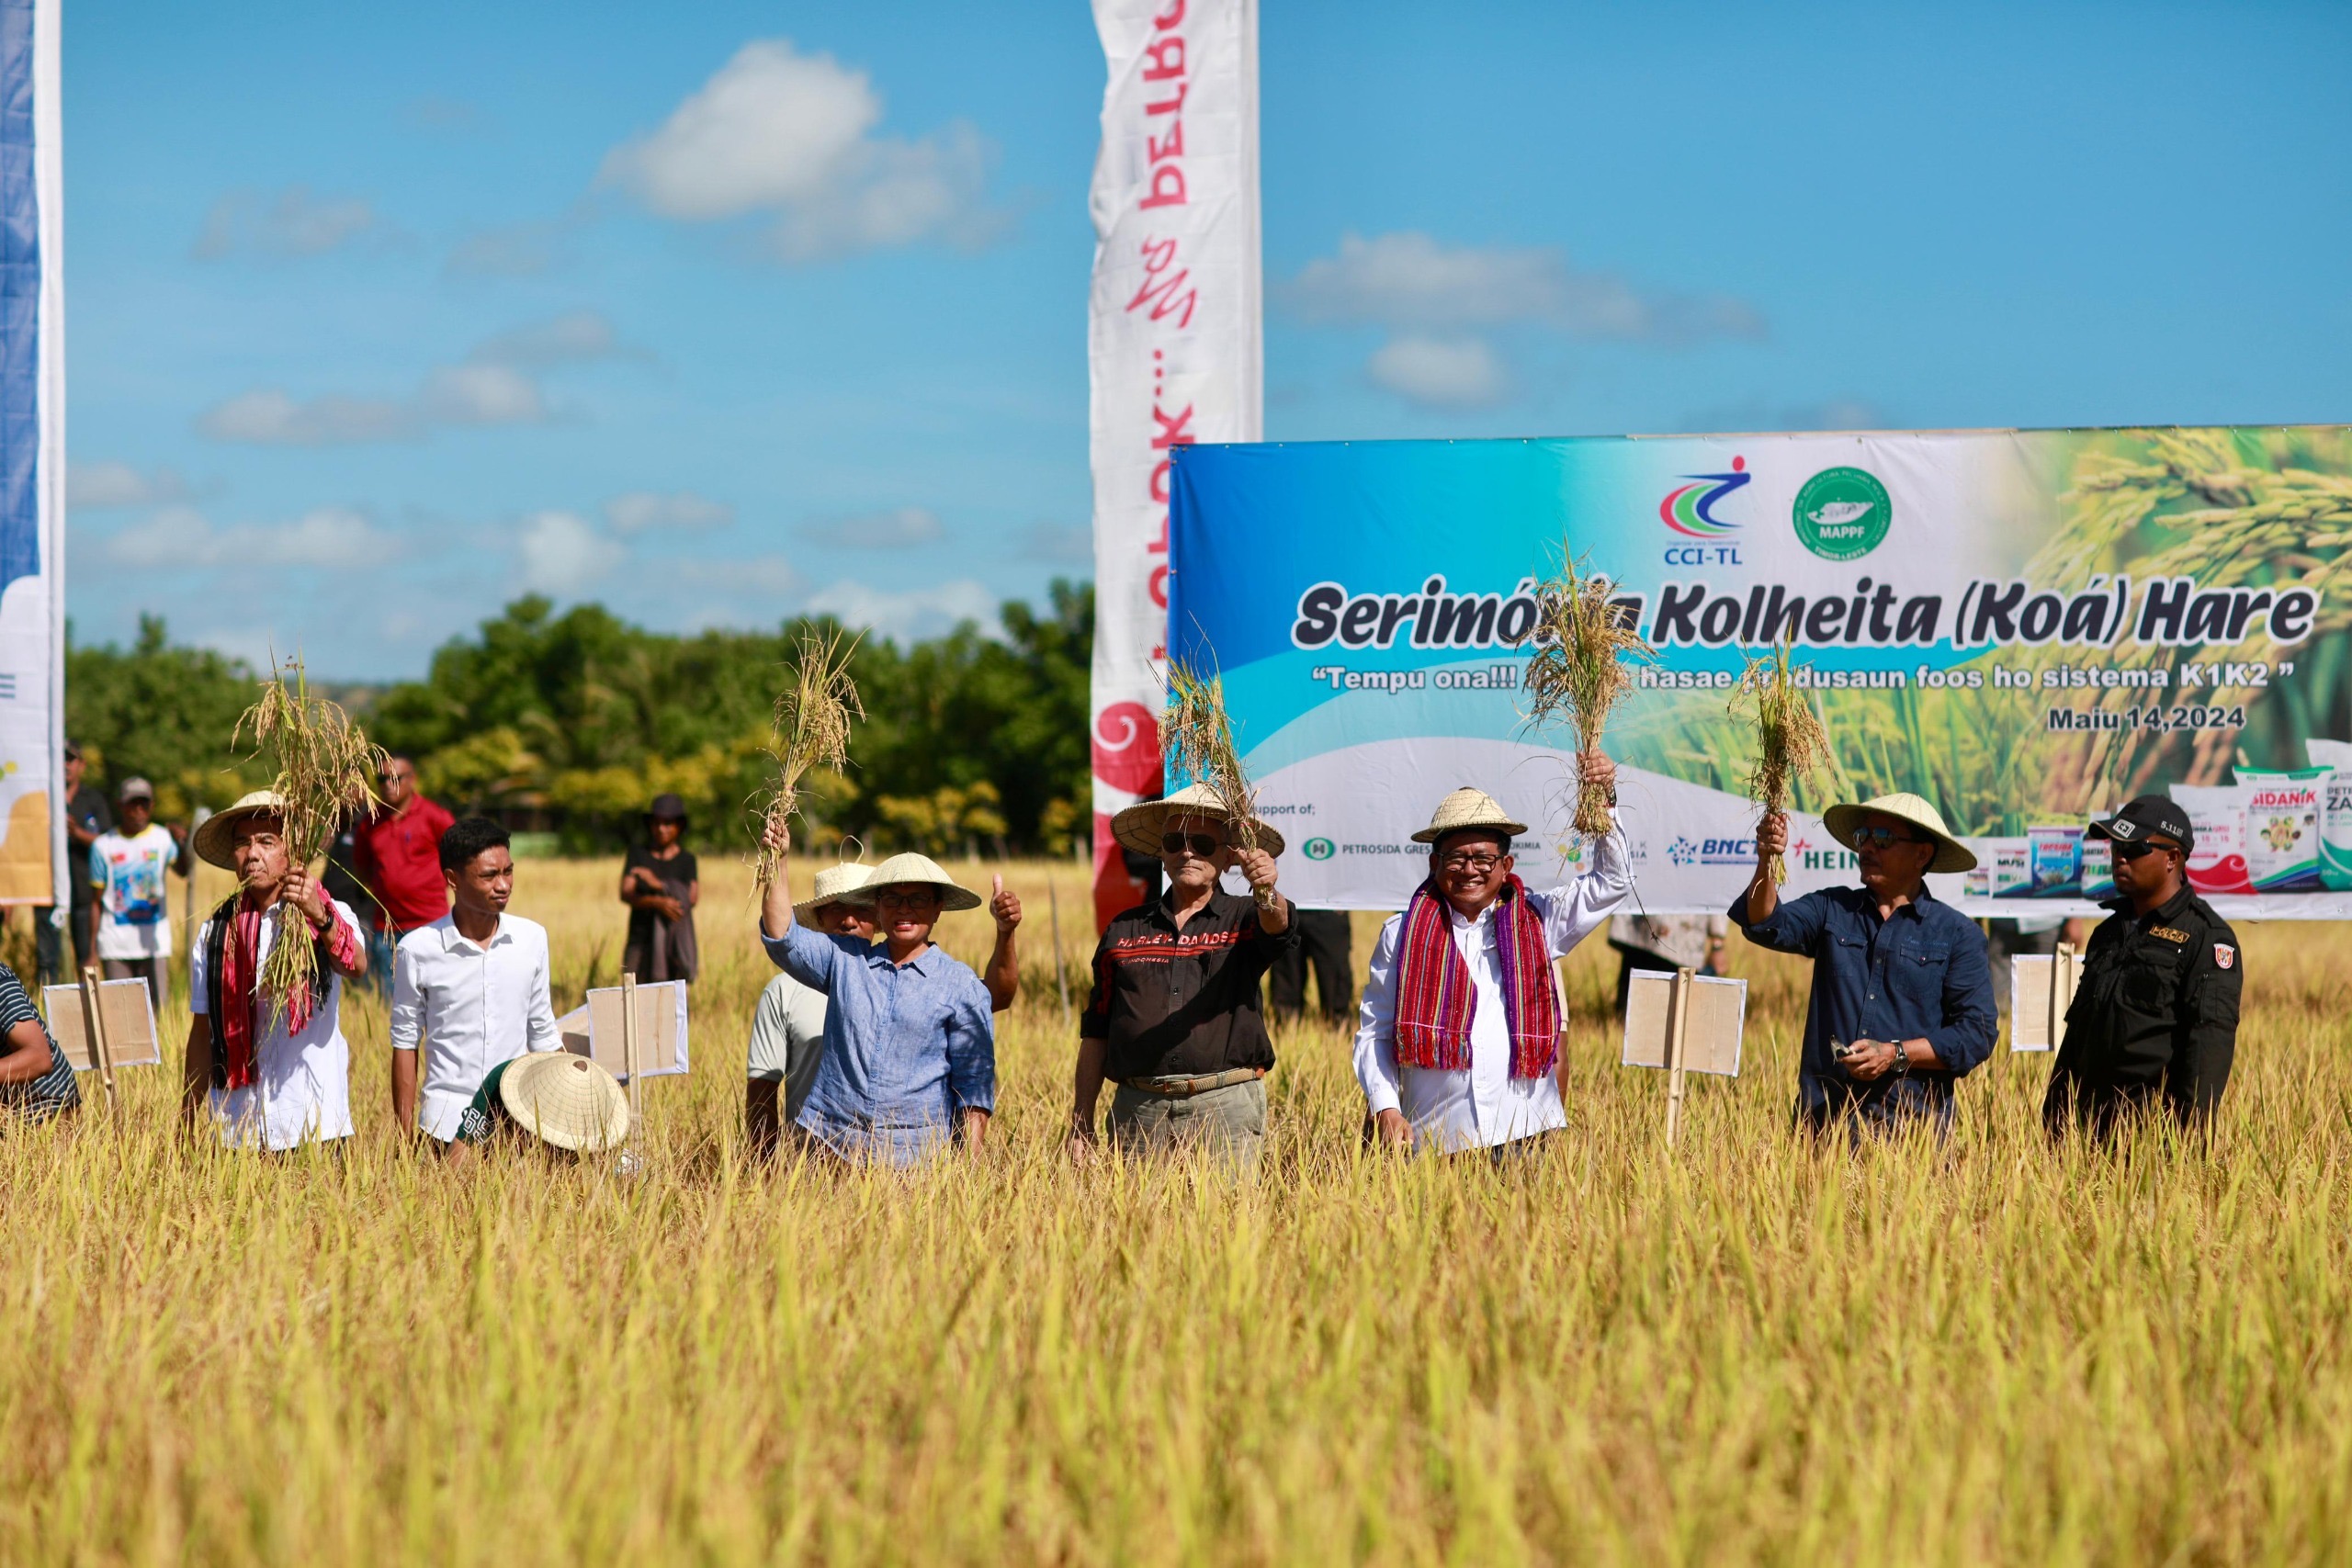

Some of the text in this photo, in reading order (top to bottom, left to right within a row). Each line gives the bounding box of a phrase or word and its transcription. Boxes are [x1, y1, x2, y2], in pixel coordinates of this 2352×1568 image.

[1819, 525, 1866, 539] MAPPF
[1664, 547, 1743, 565] CCI-TL
[1652, 576, 1943, 645] Kolheita
[1954, 579, 2127, 645] (Koá)
[2137, 581, 2314, 642] Hare
[1312, 666, 1426, 694] “Tempu
[1434, 665, 1517, 689] ona!!!
[1640, 665, 1734, 688] hasae
[1916, 663, 1983, 689] foos
[1993, 663, 2032, 689] ho
[2041, 663, 2169, 689] sistema
[2179, 662, 2268, 688] K1K2
[2049, 705, 2245, 732] Maiu 14,2024
[2160, 820, 2177, 835] 5.11
[1342, 843, 1401, 855] PETROSIDA
